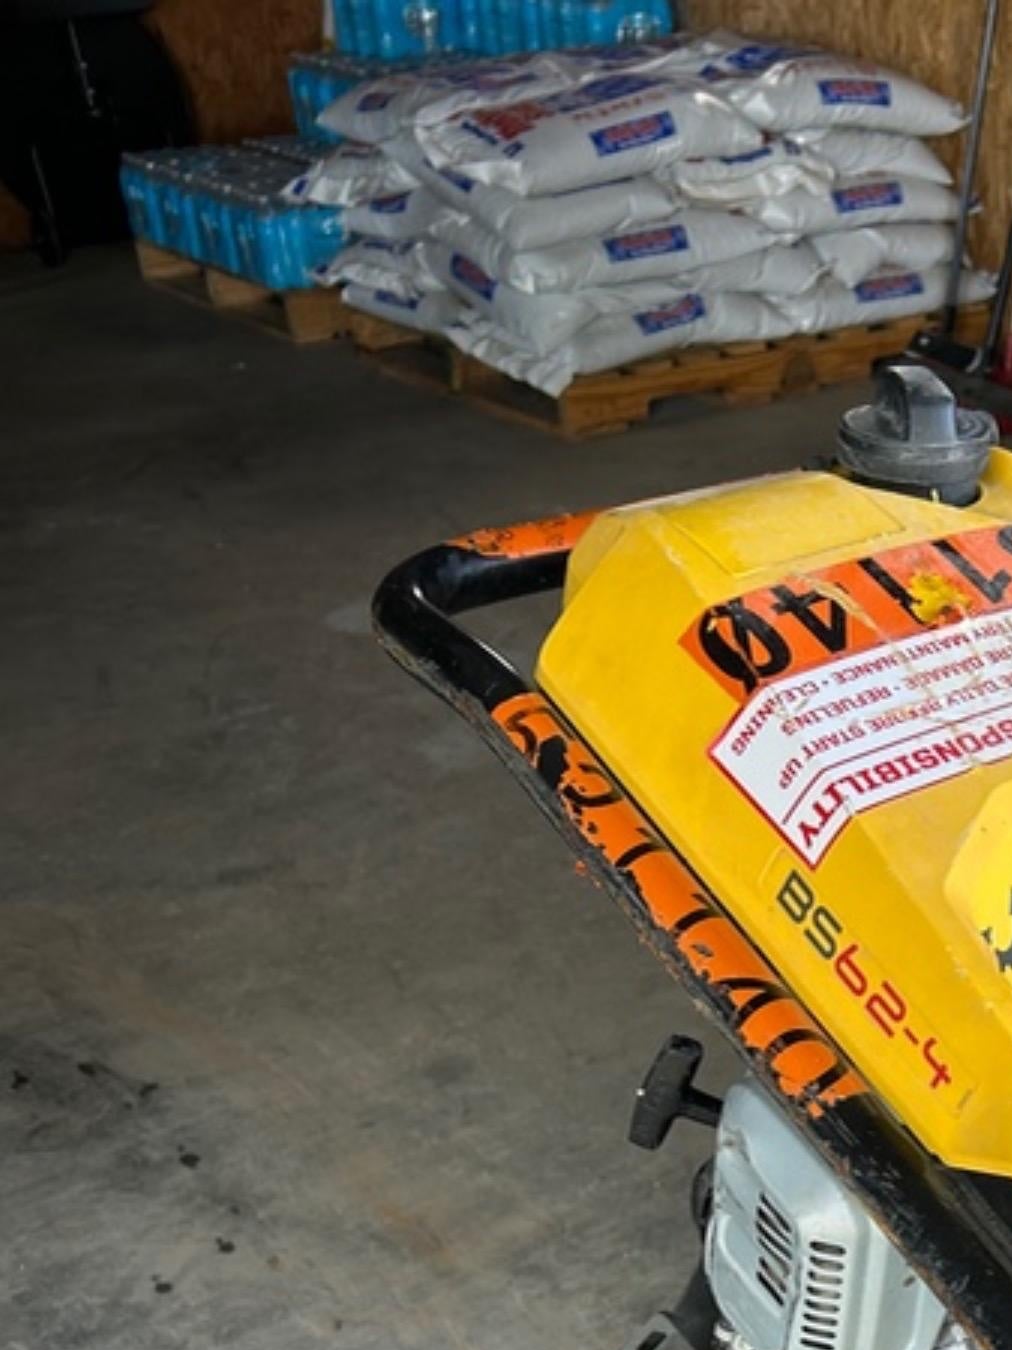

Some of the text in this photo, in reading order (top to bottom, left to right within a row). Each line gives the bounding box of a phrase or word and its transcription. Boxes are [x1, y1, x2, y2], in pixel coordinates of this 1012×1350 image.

[801, 722, 866, 760] START
[779, 758, 803, 790] UP
[775, 869, 951, 1089] BS62-4
